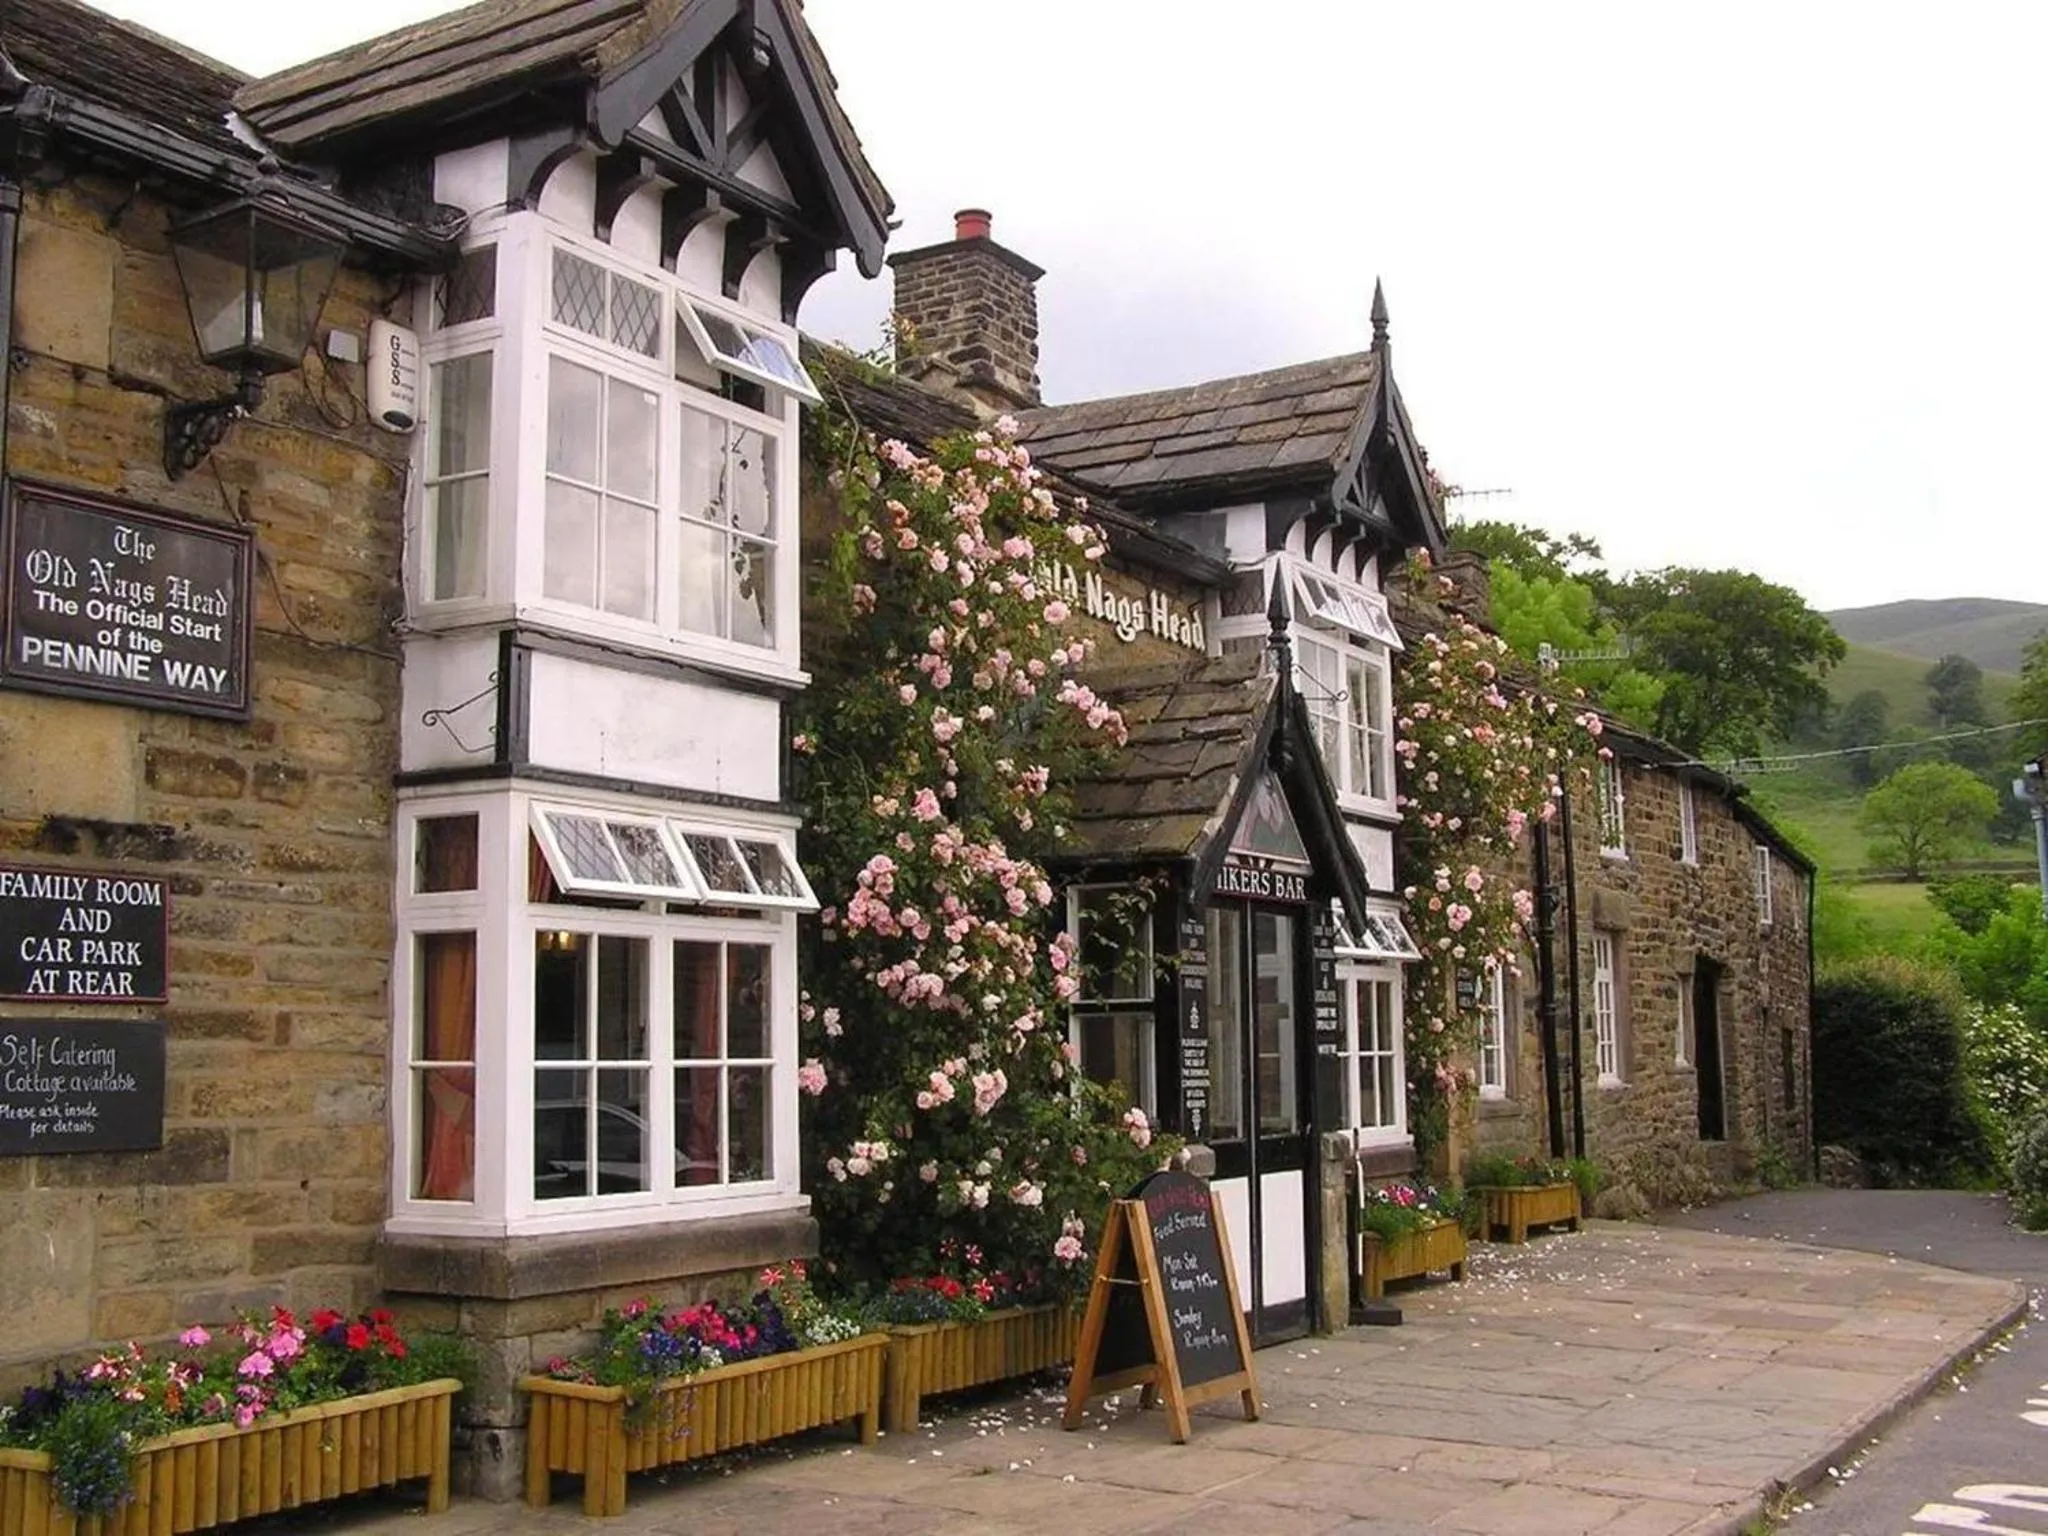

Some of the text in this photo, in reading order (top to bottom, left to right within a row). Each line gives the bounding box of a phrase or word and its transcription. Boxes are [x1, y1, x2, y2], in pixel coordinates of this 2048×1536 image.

[114, 526, 156, 564] The
[27, 550, 228, 617] Old Nags Head
[33, 590, 222, 642] The Official Start
[1086, 571, 1146, 642] Nags
[1151, 589, 1206, 651] Head
[97, 628, 163, 653] of the
[22, 636, 227, 693] PENNINE WAY
[0, 872, 163, 906] FAMILY ROOM
[1275, 872, 1306, 900] BAR
[58, 907, 112, 933] AND
[21, 937, 143, 965] CAR PARK
[27, 969, 135, 995] AT REAR
[0, 1034, 117, 1079] Self Catering
[5, 1070, 138, 1102] Cottage available
[0, 1101, 99, 1120] Please ask inside
[30, 1119, 95, 1139] for details
